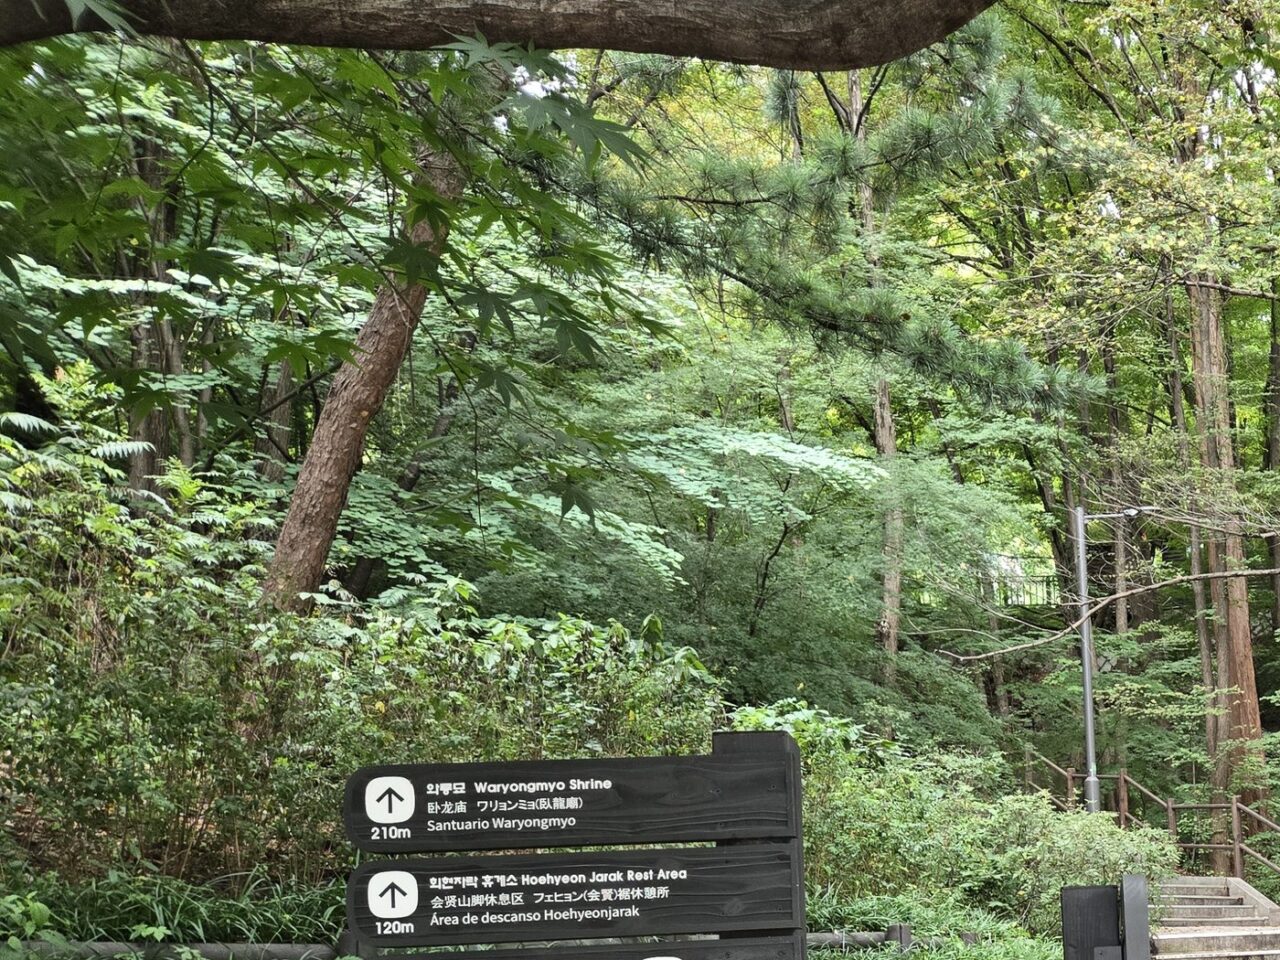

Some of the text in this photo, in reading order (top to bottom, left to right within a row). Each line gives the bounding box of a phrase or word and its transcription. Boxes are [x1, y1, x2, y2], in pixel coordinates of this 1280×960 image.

[474, 782, 565, 794] Waryongmyo
[570, 779, 612, 789] Shrine
[428, 801, 466, 814] 卧龙庙
[428, 818, 576, 831] Santuario Waryongmyo
[371, 826, 410, 839] 210m
[482, 875, 518, 887] 휴게소
[522, 874, 586, 885] Hoehyeon
[590, 871, 623, 882] Jarak
[627, 870, 653, 880] Rest
[657, 869, 687, 879] Area
[431, 893, 524, 908] 会贤山脚休息区
[430, 905, 639, 925] Área de descanso Hoehyeonjarak
[376, 921, 414, 934] 120m
